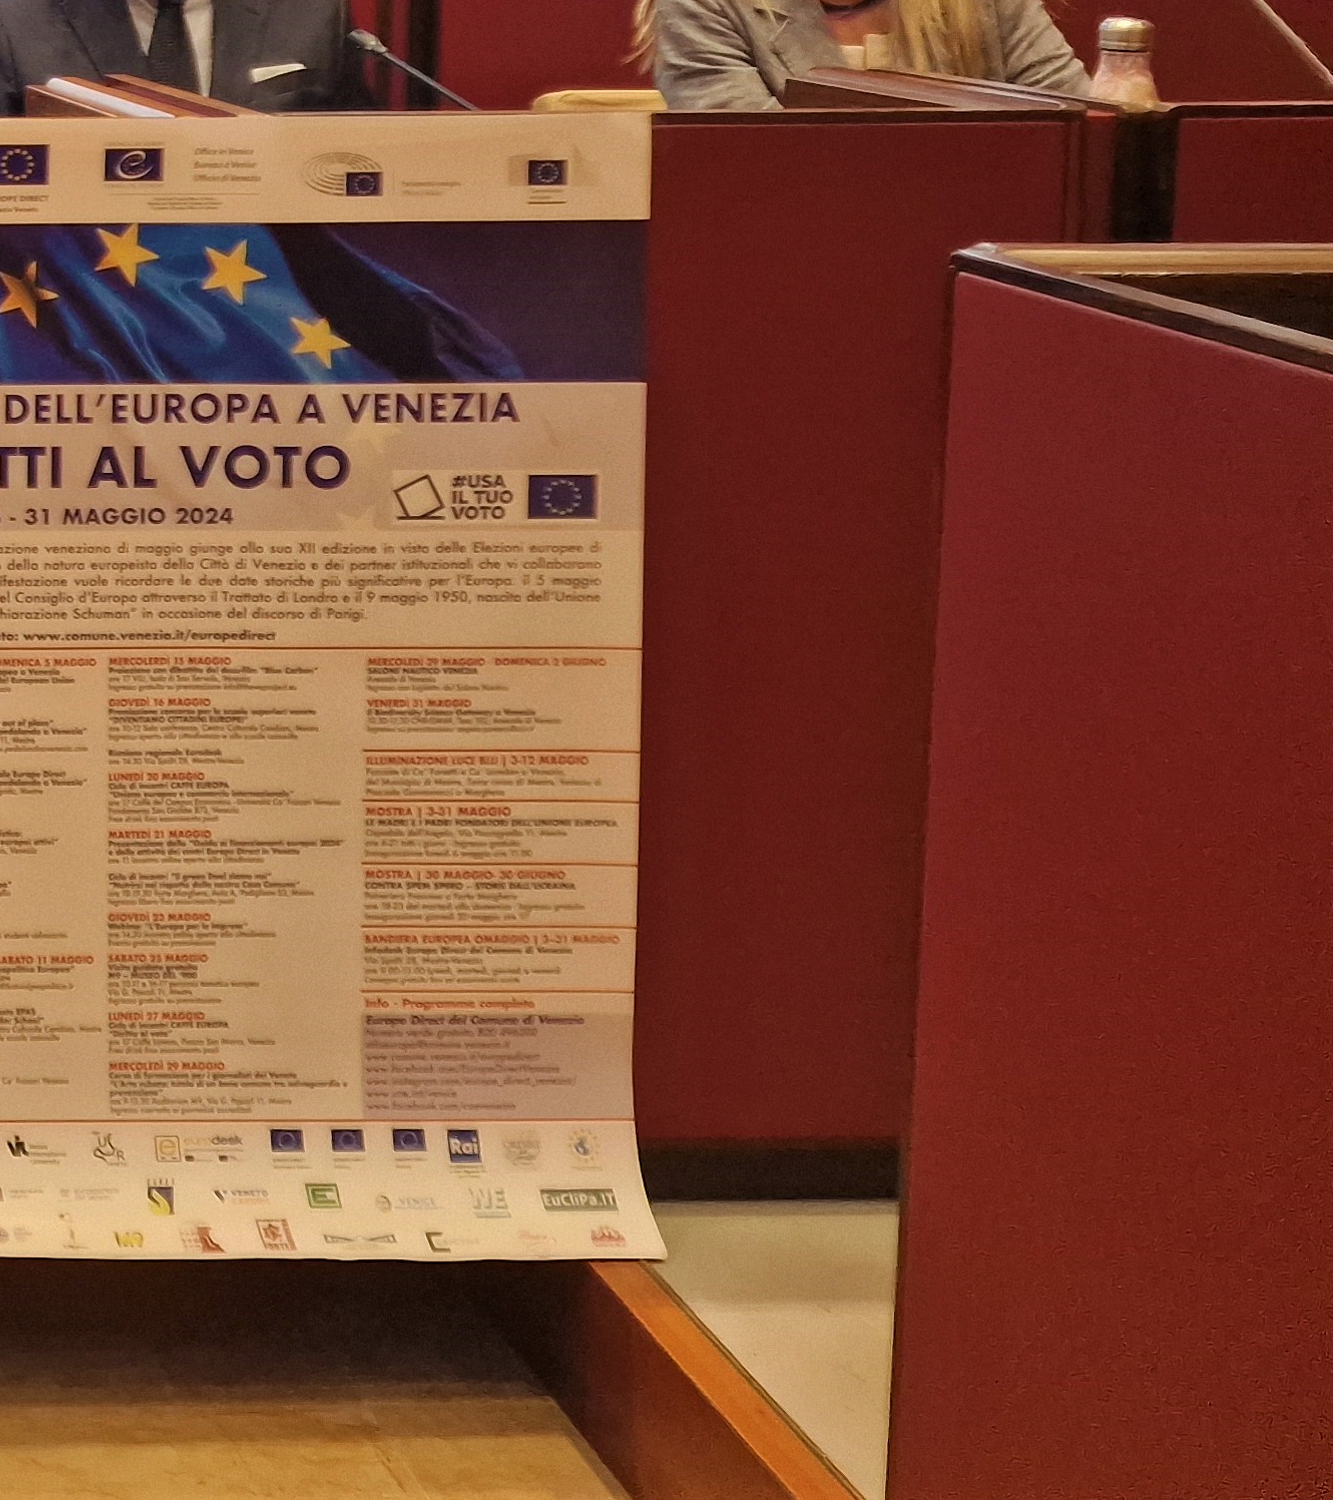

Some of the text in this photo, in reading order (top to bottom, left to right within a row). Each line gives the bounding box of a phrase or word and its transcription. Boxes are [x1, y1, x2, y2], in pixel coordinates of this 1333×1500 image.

[5, 393, 279, 424] DELL'EUROPA
[297, 394, 324, 423] A
[342, 393, 519, 423] VENEZIA
[87, 446, 157, 488] AL
[179, 445, 349, 489] VOTO
[452, 475, 506, 488] #USA
[452, 490, 513, 504] IL TUO
[24, 508, 48, 525] 31
[63, 507, 165, 524] MAGGIO
[176, 507, 232, 524] 2024
[451, 506, 505, 519] VOTO
[44, 542, 110, 553] veneziana
[117, 542, 128, 553] di
[135, 542, 183, 556] maggio
[189, 542, 233, 556] giunge
[239, 542, 263, 553] alla
[270, 545, 291, 553] sua
[297, 542, 315, 553] XII
[321, 542, 376, 553] edizione
[383, 542, 394, 553] in
[401, 541, 428, 553] vista
[435, 541, 465, 553] delle
[472, 541, 523, 553] Elezioni
[529, 545, 582, 556] europee
[590, 541, 601, 553] di
[7, 559, 38, 570] della
[44, 559, 84, 570] natura
[90, 559, 156, 573] europeista
[161, 558, 194, 570] della
[199, 558, 230, 570] Città
[234, 558, 246, 570] di
[251, 558, 305, 570] Venezia
[310, 561, 318, 570] e
[324, 558, 343, 570] dei
[349, 558, 394, 573] partner
[402, 558, 472, 570] istituzionali
[478, 558, 500, 569] che
[507, 558, 517, 569] vi
[74, 575, 108, 586] vuole
[115, 575, 173, 586] ricordare
[180, 575, 191, 586] le
[198, 575, 221, 586] due
[229, 575, 260, 586] date
[265, 575, 314, 586] storiche
[348, 575, 421, 589] significative
[427, 578, 449, 589] per
[522, 575, 529, 586] il
[536, 575, 544, 586] 5
[552, 575, 601, 589] maggio
[14, 592, 74, 606] Consiglio
[78, 592, 137, 606] d'Europa
[141, 592, 206, 603] attraverso
[210, 592, 217, 603] il
[221, 592, 271, 603] Trattato
[276, 592, 288, 603] di
[293, 592, 337, 603] Londra
[354, 592, 362, 602] il
[366, 592, 375, 602] 9
[379, 591, 428, 605] maggio
[435, 591, 471, 605] 1950,
[477, 591, 521, 602] nascita
[527, 591, 599, 602] dell'Unione
[72, 608, 136, 619] Schuman"
[141, 608, 153, 619] in
[157, 608, 221, 619] occasione
[227, 608, 246, 619] del
[252, 608, 304, 619] discorso
[309, 608, 321, 619] di
[449, 1136, 479, 1155] Rai
